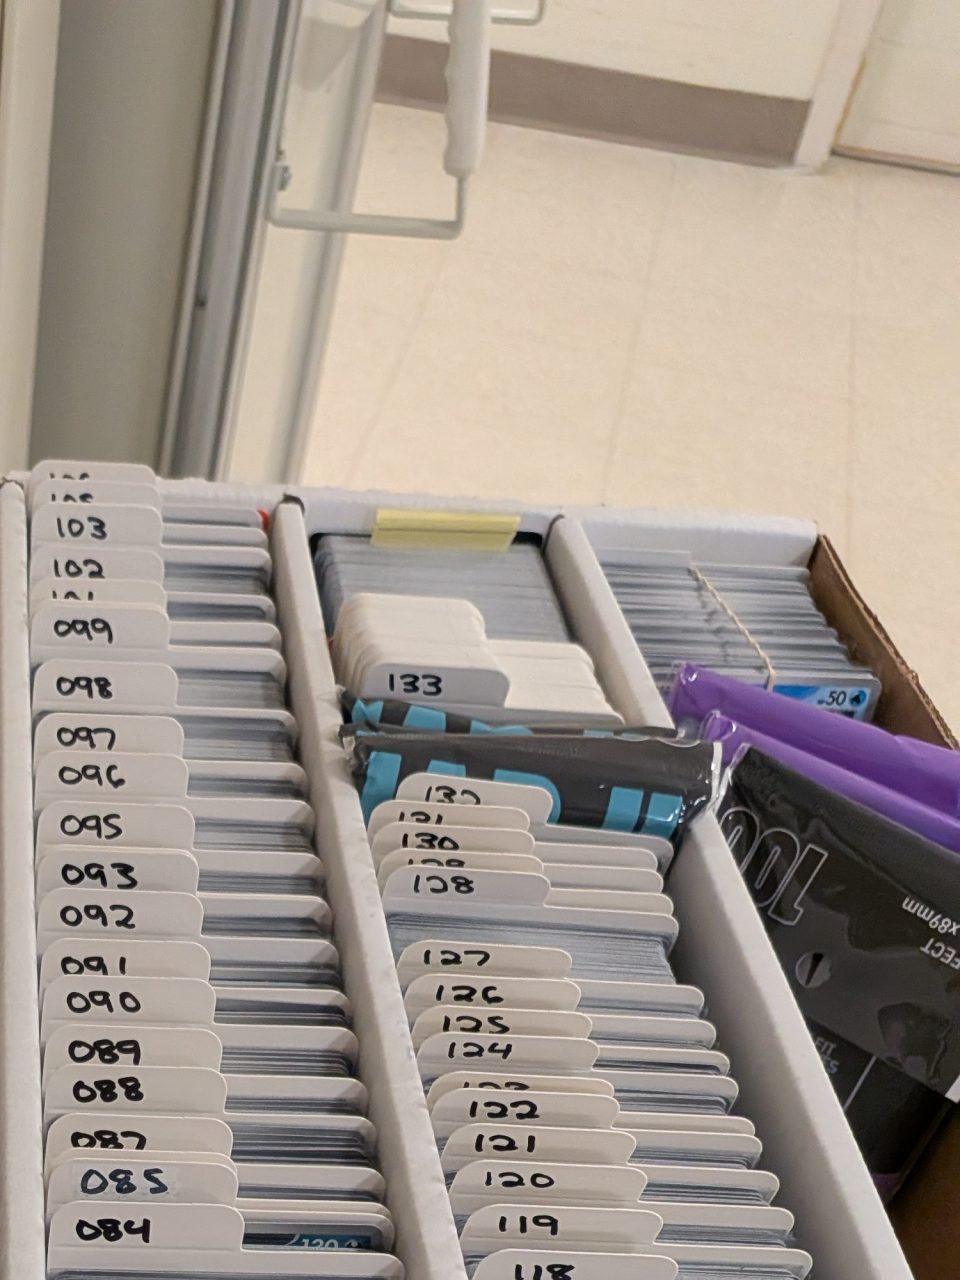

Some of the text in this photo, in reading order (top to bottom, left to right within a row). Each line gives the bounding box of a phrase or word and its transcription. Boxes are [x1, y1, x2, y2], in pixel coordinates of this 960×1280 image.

[57, 516, 108, 540] 103
[54, 558, 105, 579] 102
[53, 618, 113, 644] 099
[56, 676, 113, 699] 098
[389, 673, 443, 696] 133
[825, 690, 847, 706] 50
[56, 726, 116, 750] 097
[58, 764, 126, 789] 096
[60, 814, 123, 839] 095
[402, 832, 460, 850] 130
[61, 862, 138, 889] 093
[413, 875, 475, 894] 128
[60, 904, 136, 929] 092
[61, 956, 126, 976] 091
[423, 949, 490, 967] 127
[66, 990, 141, 1014] 090
[435, 984, 504, 1004] 126
[442, 1015, 510, 1034] 125
[68, 1039, 141, 1065] 089
[448, 1042, 513, 1059] 124
[72, 1076, 144, 1103] 088
[469, 1100, 540, 1119] 122
[71, 1130, 147, 1150] 087
[475, 1133, 536, 1152] 121
[80, 1167, 169, 1195] 085
[485, 1171, 554, 1188] 120
[75, 1218, 151, 1244] 084
[498, 1214, 559, 1236] 119
